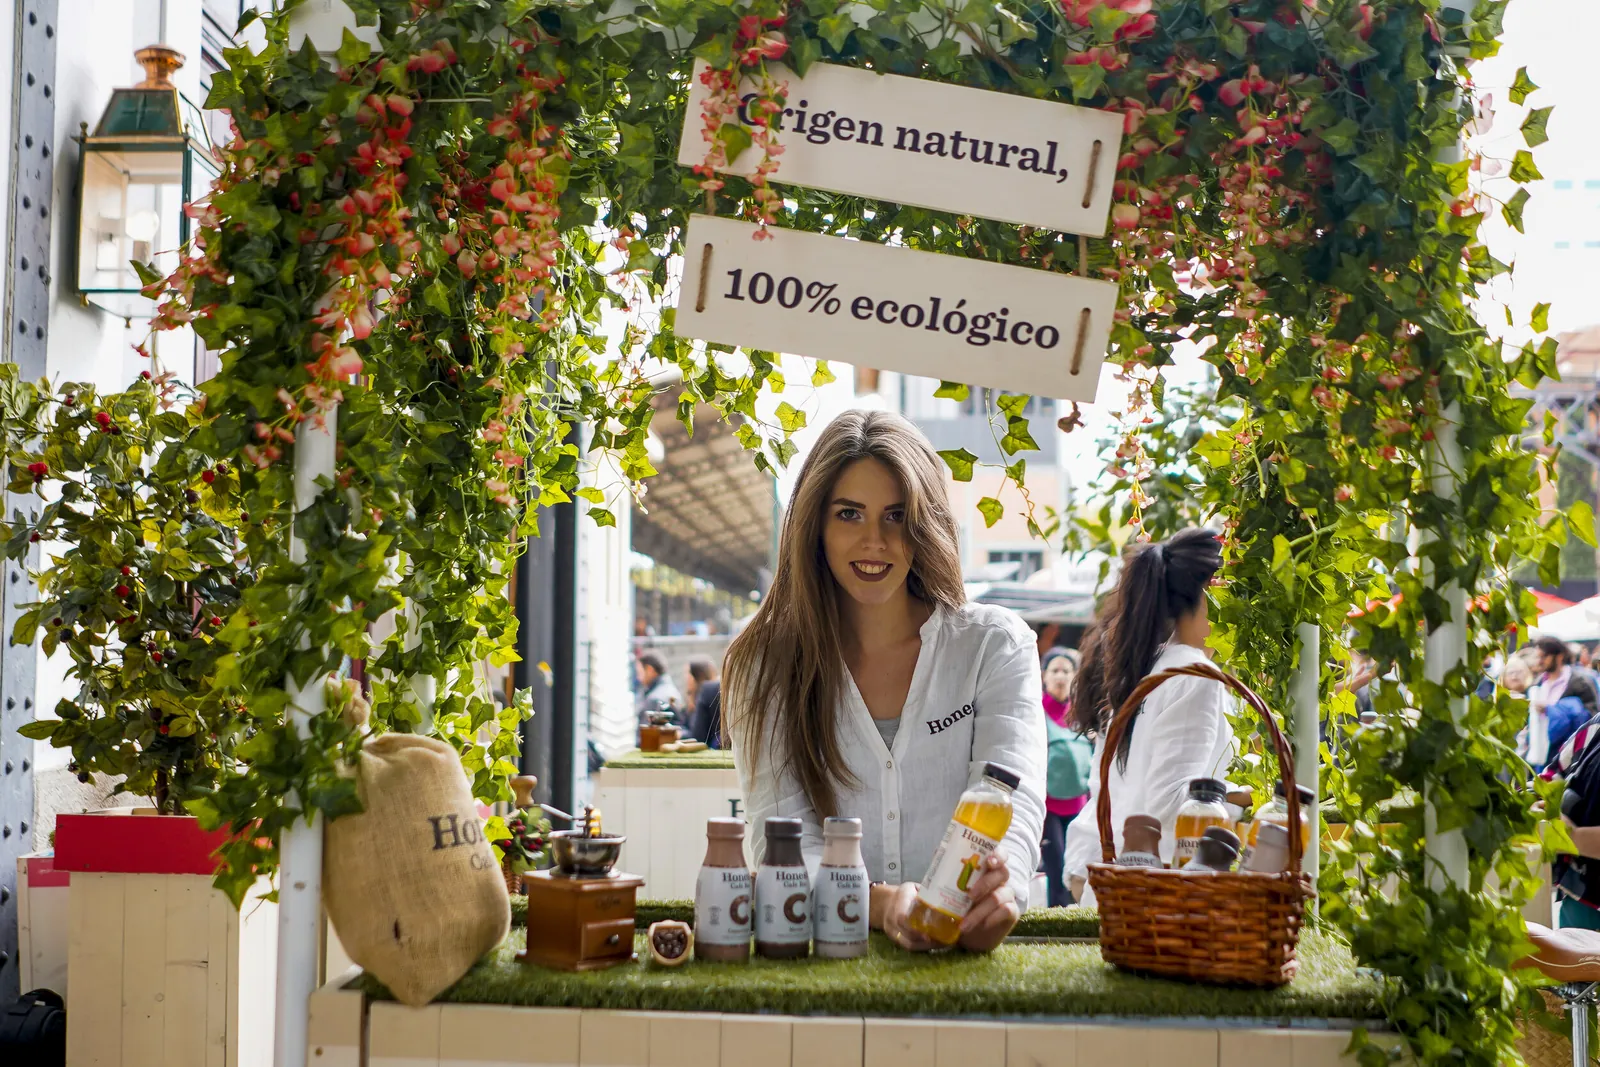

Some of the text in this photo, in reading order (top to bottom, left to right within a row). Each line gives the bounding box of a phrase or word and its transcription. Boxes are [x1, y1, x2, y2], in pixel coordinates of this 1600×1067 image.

[893, 126, 1069, 184] natural,
[724, 268, 1061, 350] 100% ecológico
